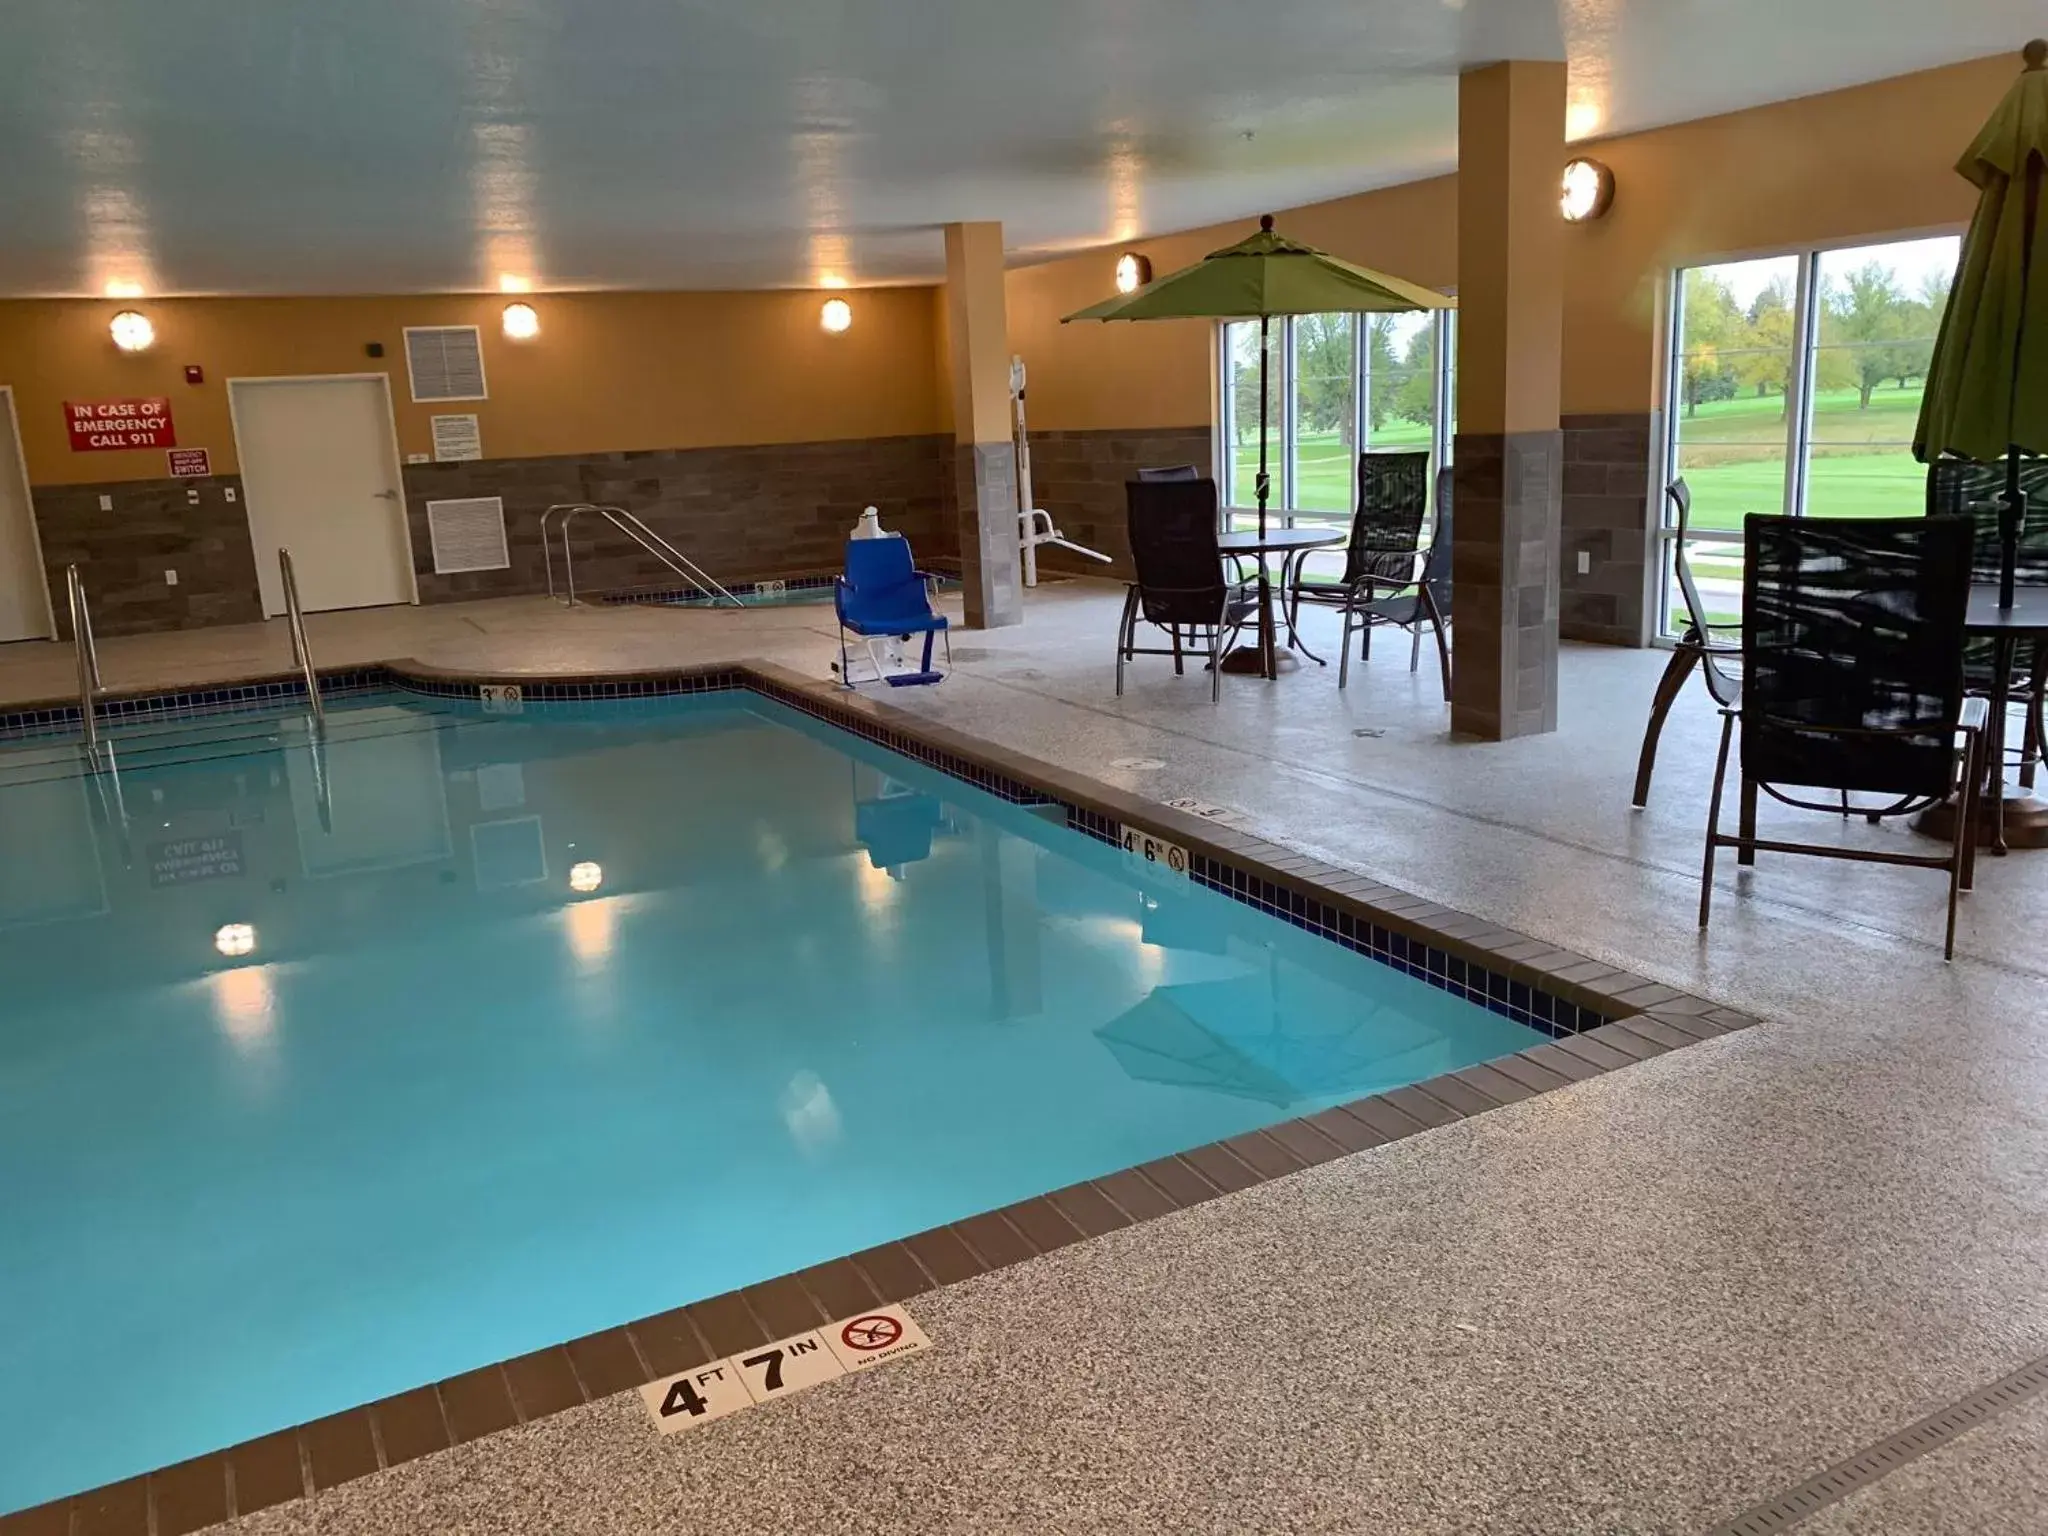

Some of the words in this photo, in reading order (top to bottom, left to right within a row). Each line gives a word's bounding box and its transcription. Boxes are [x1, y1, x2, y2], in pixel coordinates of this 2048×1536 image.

[74, 405, 93, 418] IN
[98, 403, 136, 417] CASE
[141, 402, 161, 415] OF
[74, 417, 167, 433] EMERGENCY
[90, 434, 127, 447] CALL
[130, 433, 156, 445] 911
[174, 464, 206, 474] SWITCH
[1123, 831, 1135, 852] 4
[1145, 838, 1156, 862] 6
[857, 1355, 876, 1365] NO
[878, 1342, 918, 1359] DIVING
[659, 1378, 709, 1418] 4
[695, 1367, 725, 1387] FT
[742, 1349, 785, 1392] 7
[787, 1338, 819, 1357] IN
